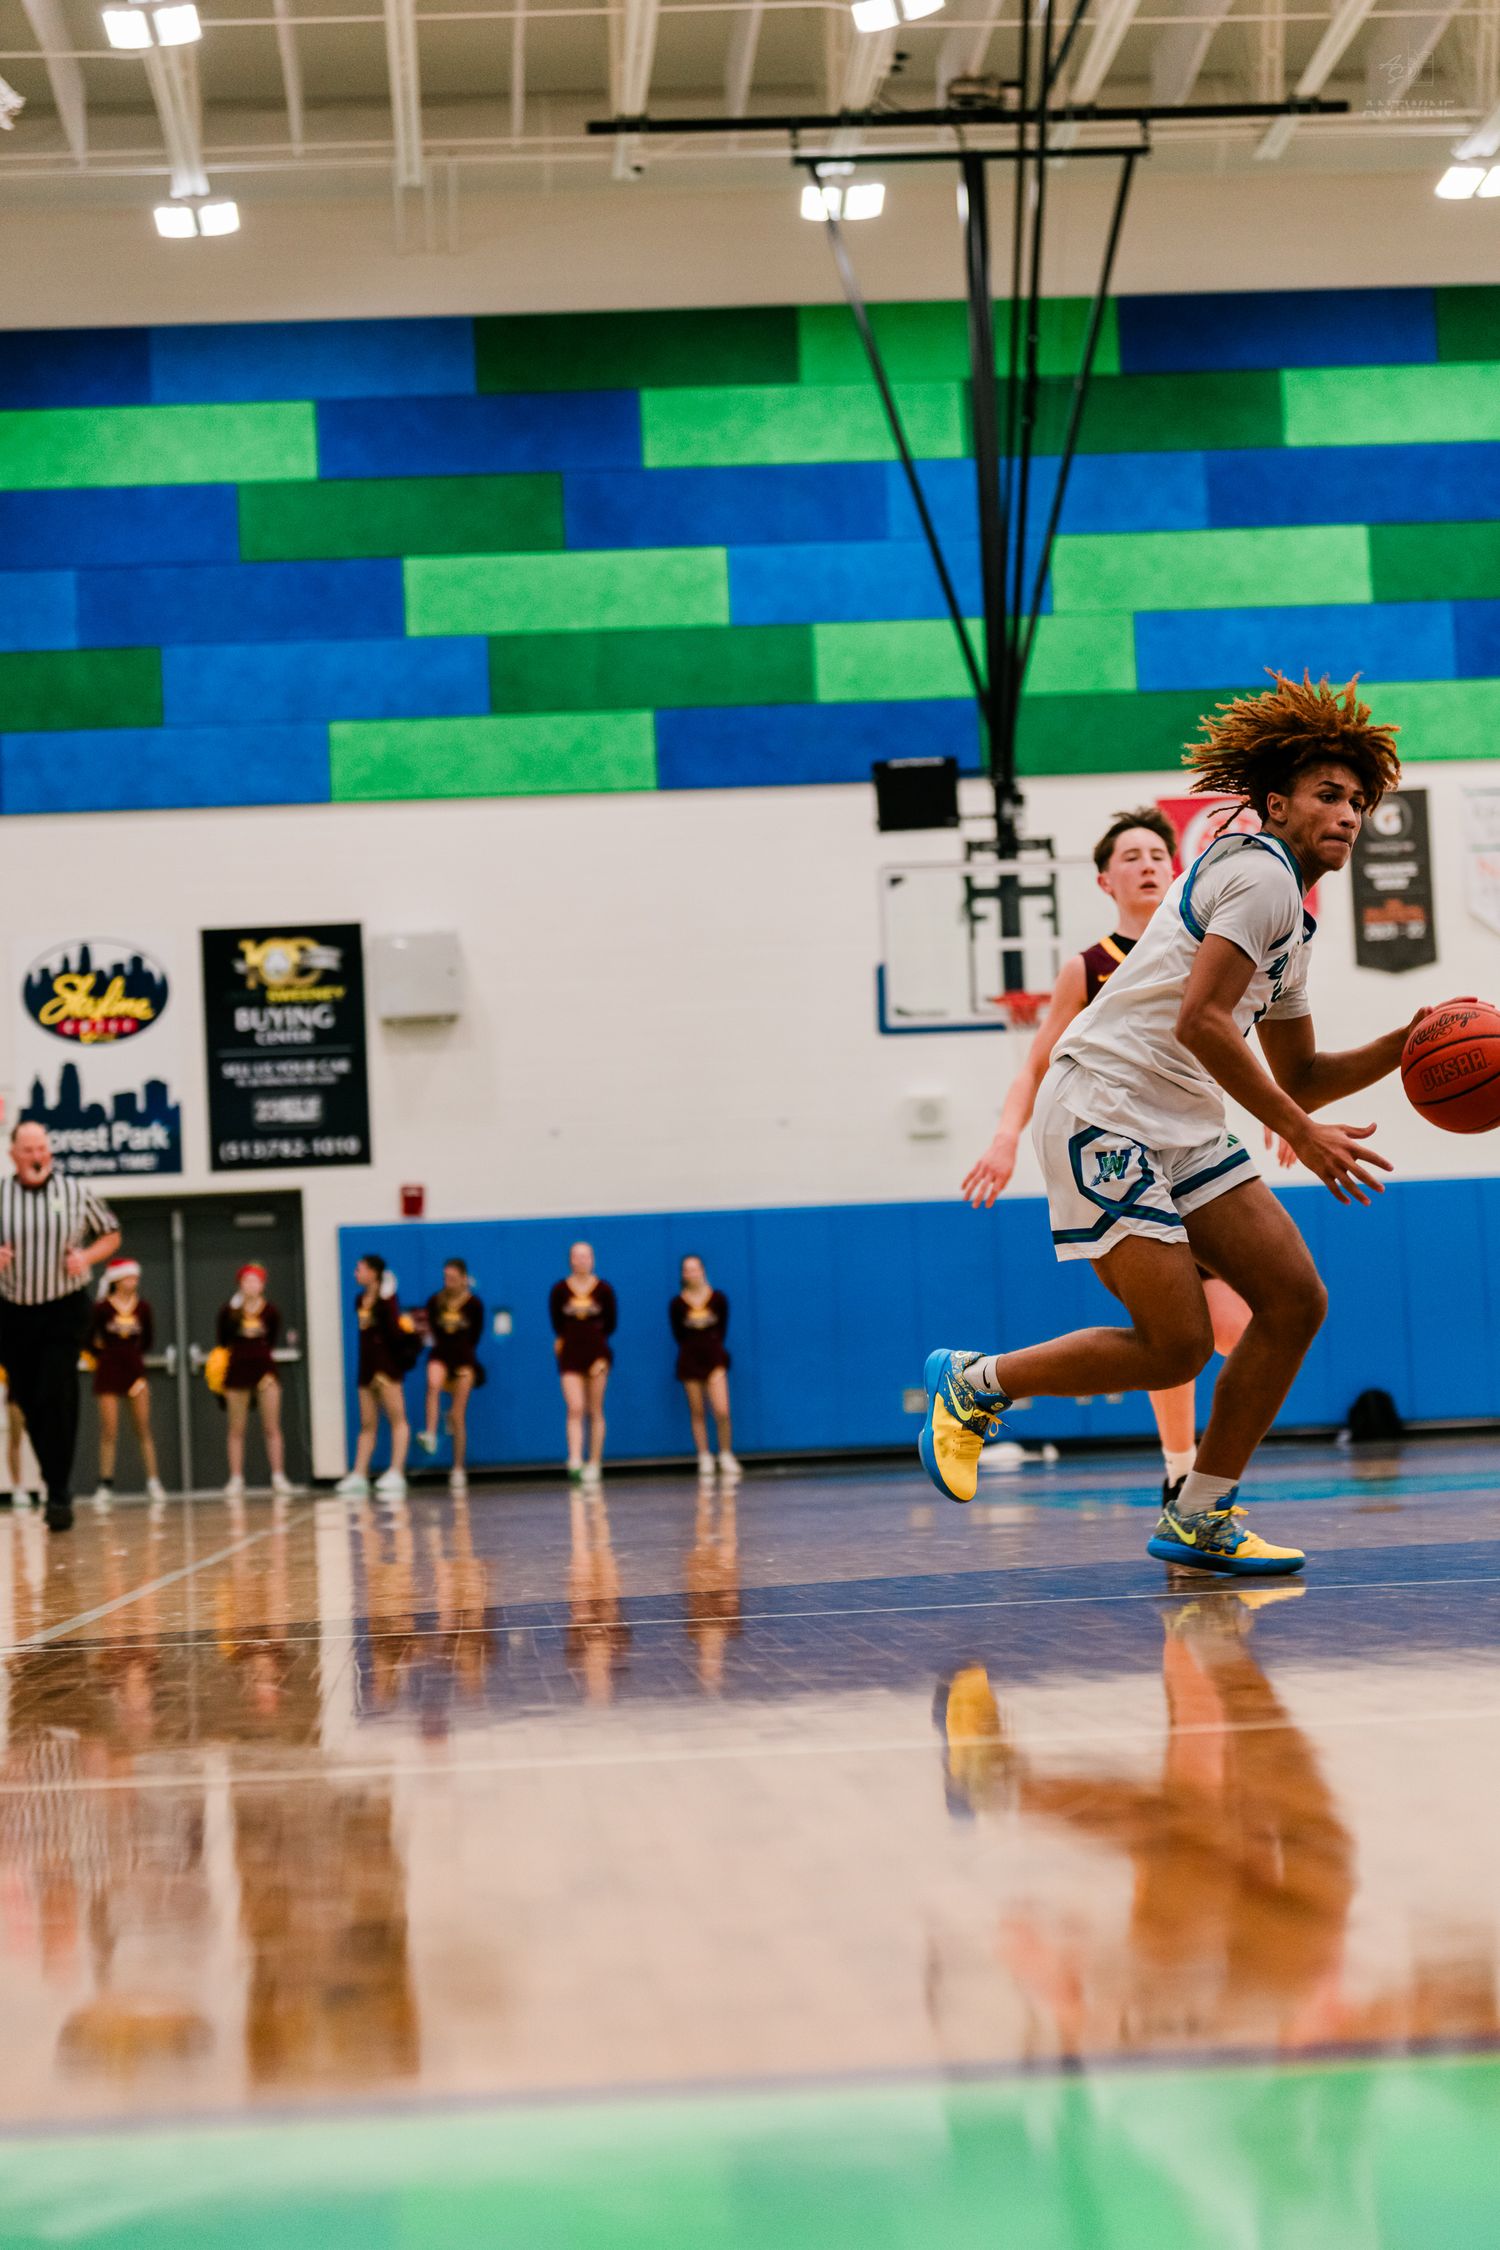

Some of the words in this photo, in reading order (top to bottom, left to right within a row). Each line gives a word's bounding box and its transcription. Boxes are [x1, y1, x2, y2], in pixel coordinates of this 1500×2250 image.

[234, 1003, 336, 1033] BUYING
[1407, 1011, 1481, 1056] Rawlings
[254, 1029, 316, 1047] CENTER
[1420, 1047, 1488, 1093] OHSAA
[49, 1124, 109, 1154] orest
[111, 1119, 170, 1151] Park
